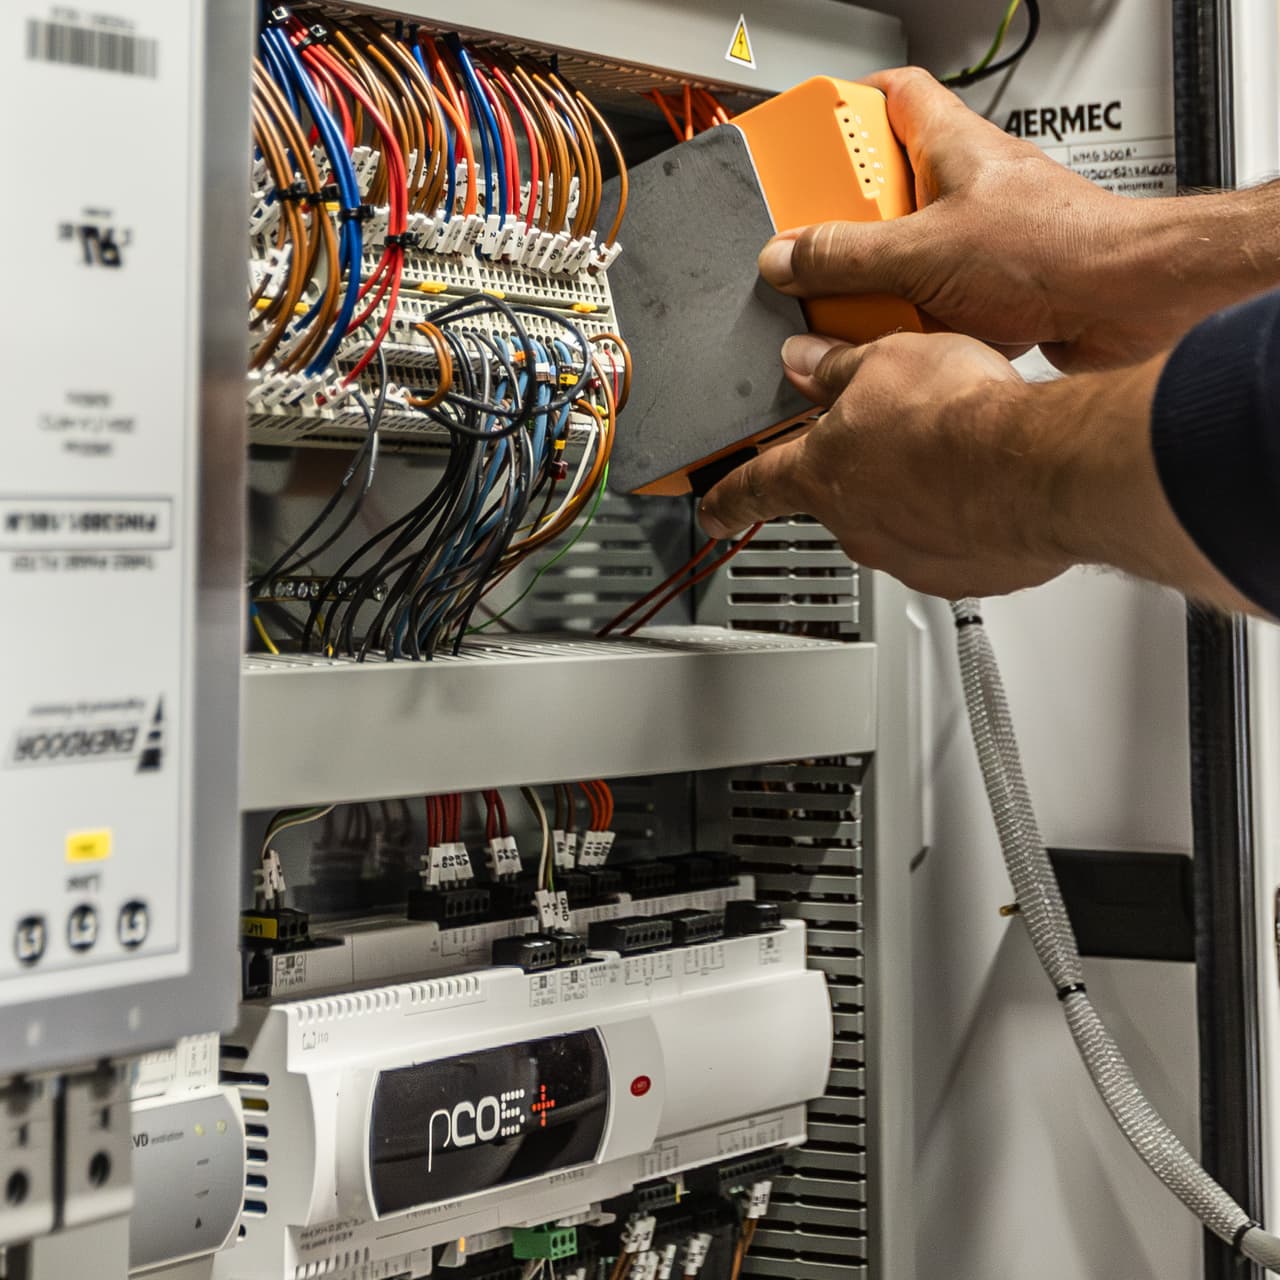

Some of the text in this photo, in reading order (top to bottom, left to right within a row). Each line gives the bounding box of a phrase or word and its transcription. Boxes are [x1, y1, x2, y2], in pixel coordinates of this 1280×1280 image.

[1005, 101, 1122, 142] AERMEC
[560, 898, 569, 922] GND
[131, 1133, 149, 1149] VD
